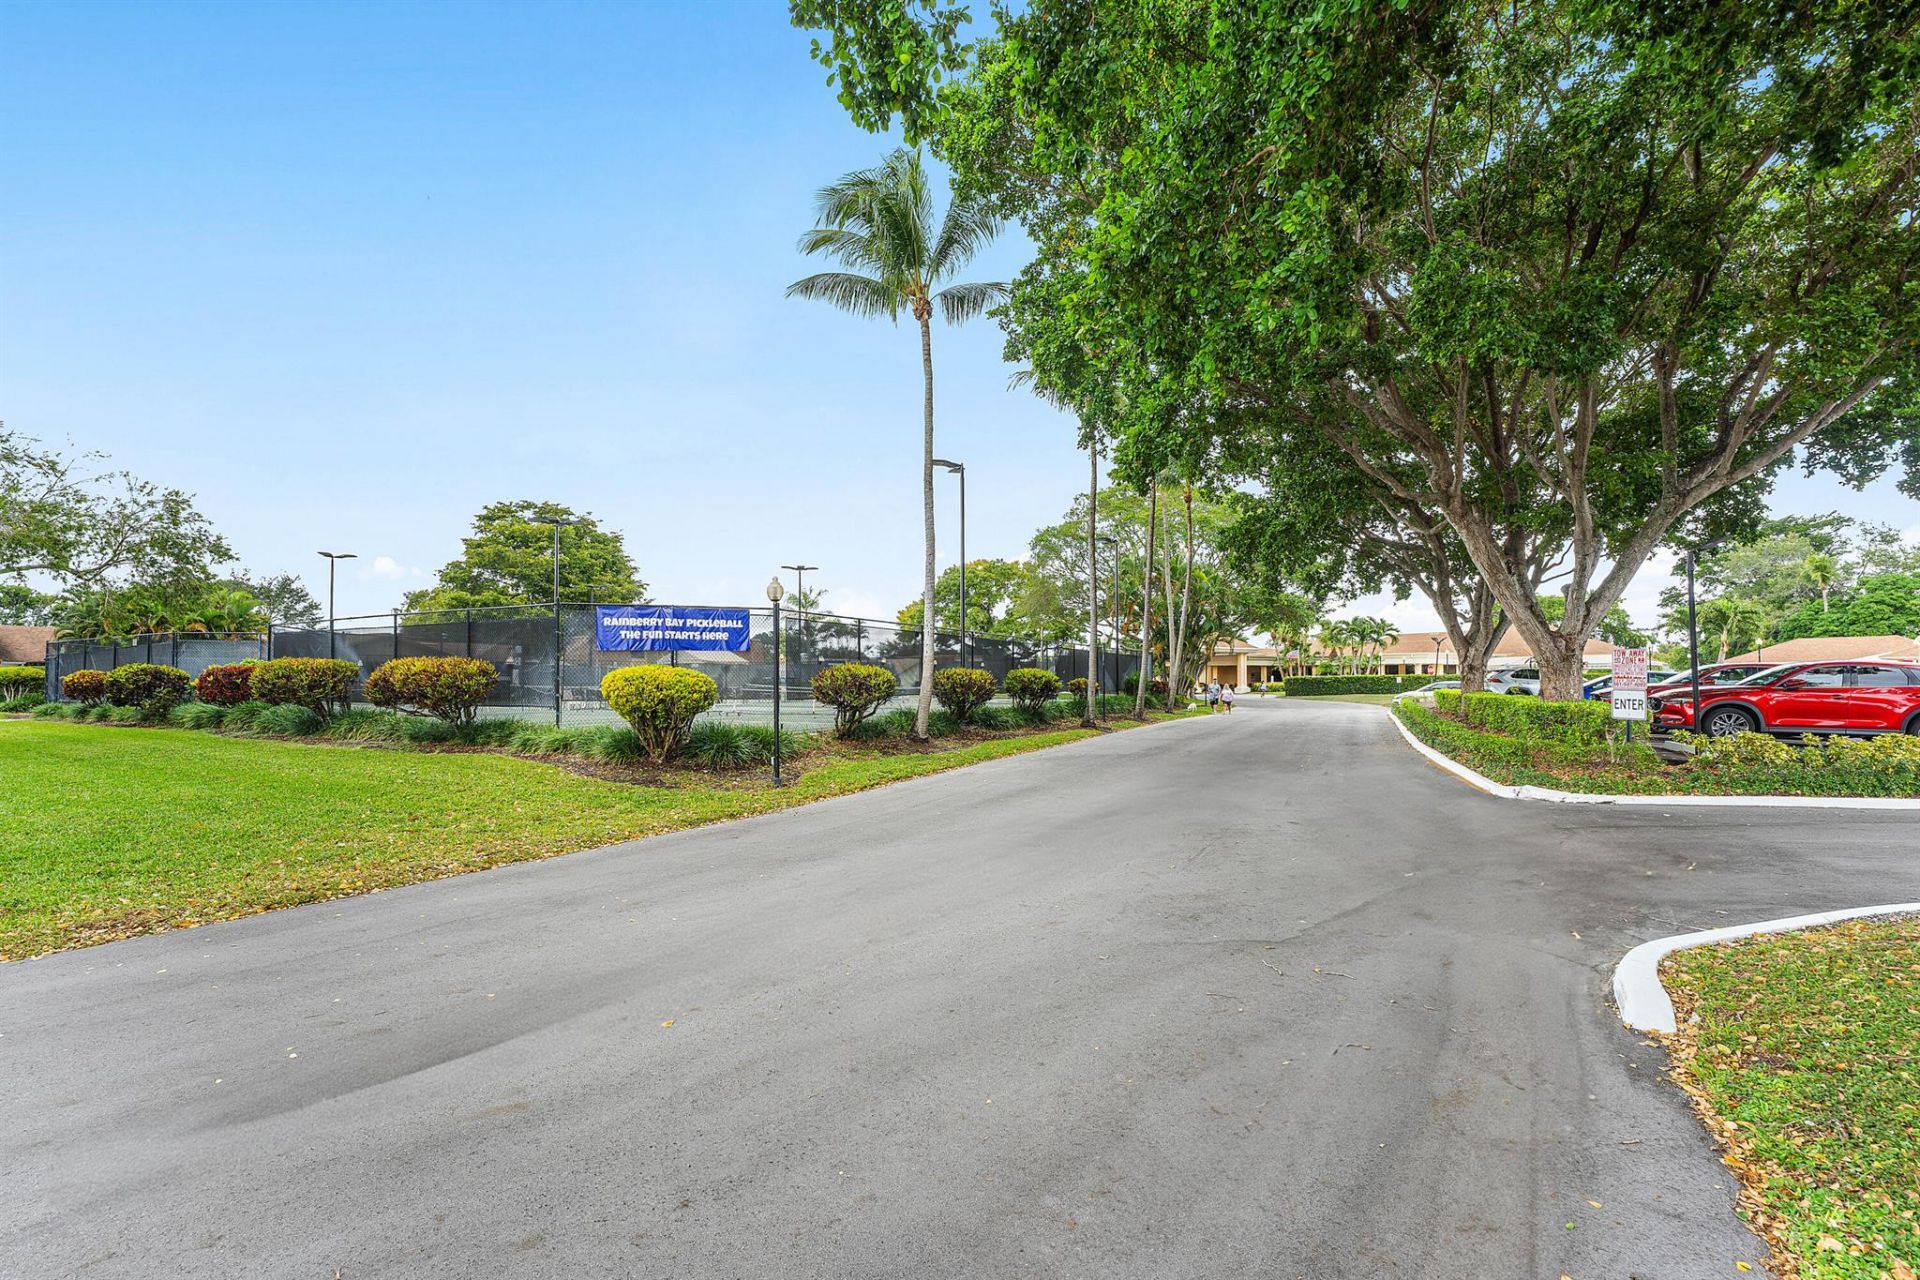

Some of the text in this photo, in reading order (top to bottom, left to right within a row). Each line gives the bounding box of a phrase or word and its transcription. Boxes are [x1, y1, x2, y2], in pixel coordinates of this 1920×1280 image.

[603, 617, 743, 628] RAINBERRY BAY PICKLEBALL
[619, 630, 729, 640] THE FUN STARTS HERE
[1614, 698, 1644, 710] ENTER
